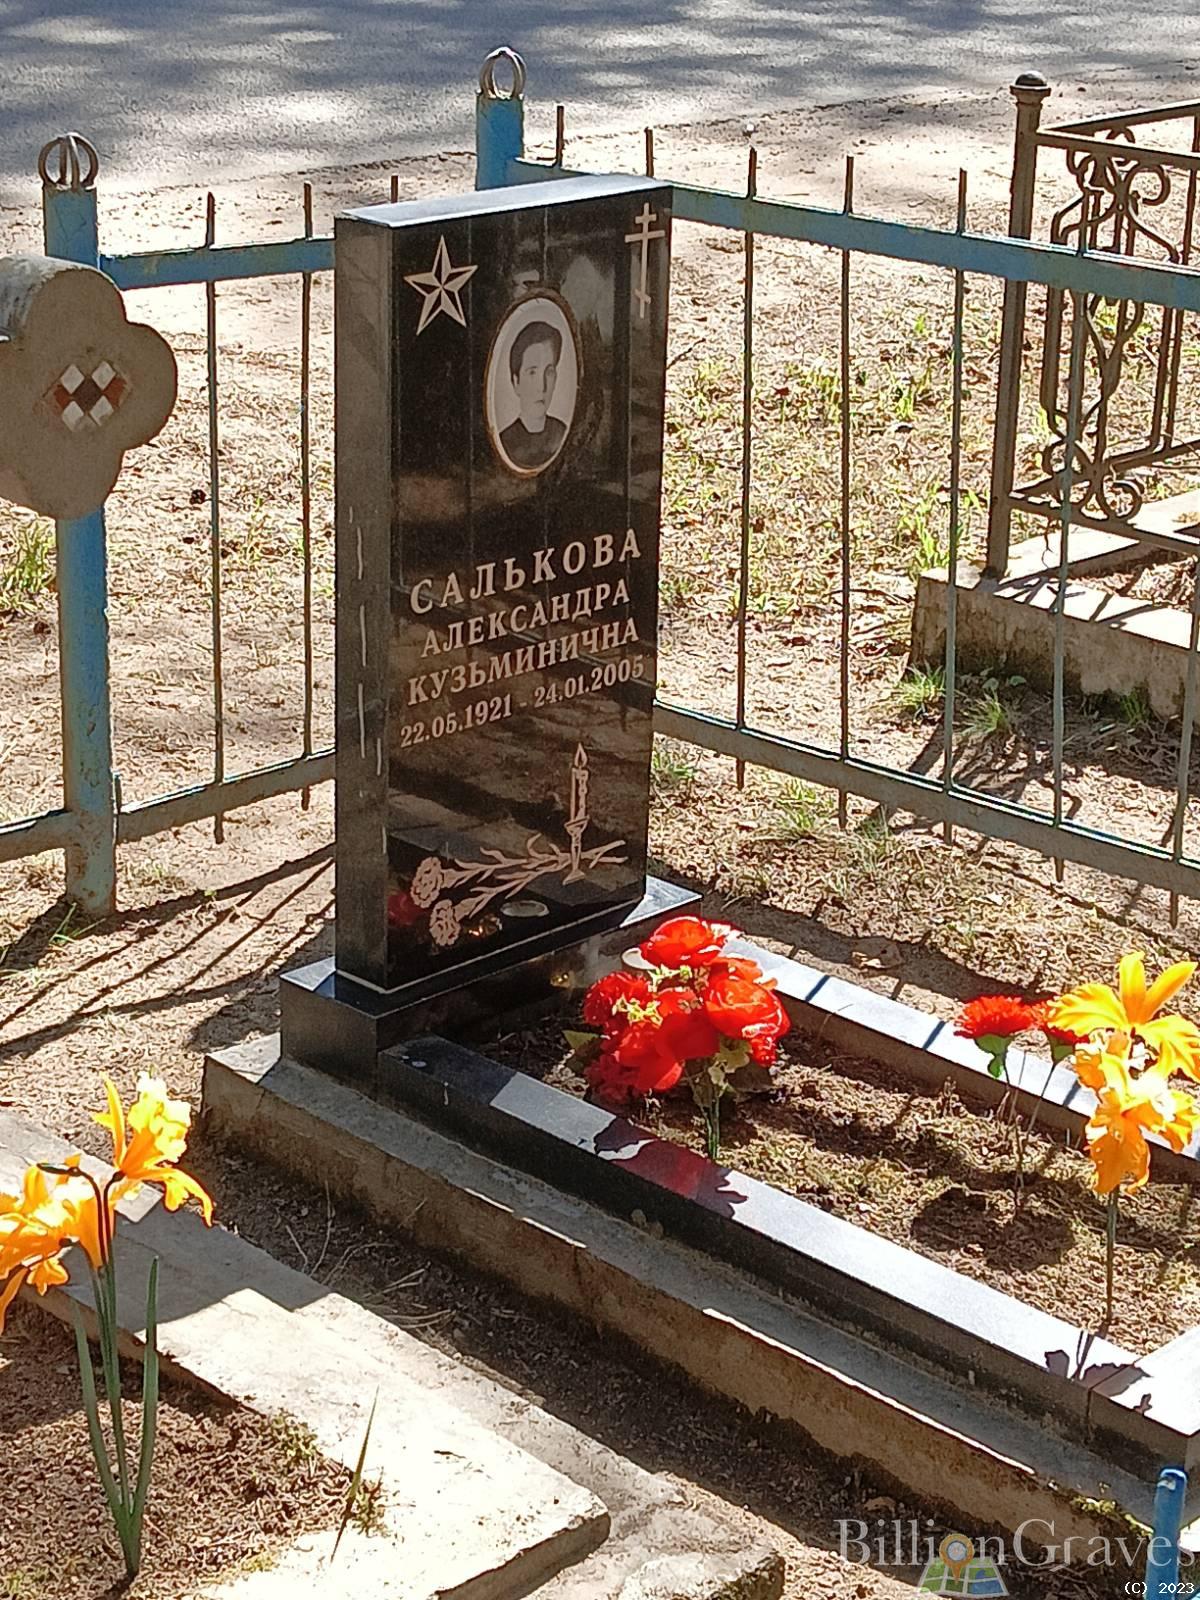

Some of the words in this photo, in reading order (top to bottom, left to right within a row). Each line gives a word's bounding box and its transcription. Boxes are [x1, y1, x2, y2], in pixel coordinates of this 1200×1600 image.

[410, 528, 641, 614] САЛЬКОВА
[421, 578, 631, 657] АЛЕКСАНДРА
[400, 693, 512, 748] 22.05.1921
[534, 654, 645, 708] 24.01.2005
[407, 617, 640, 706] КУЗЬМИНИЧНА
